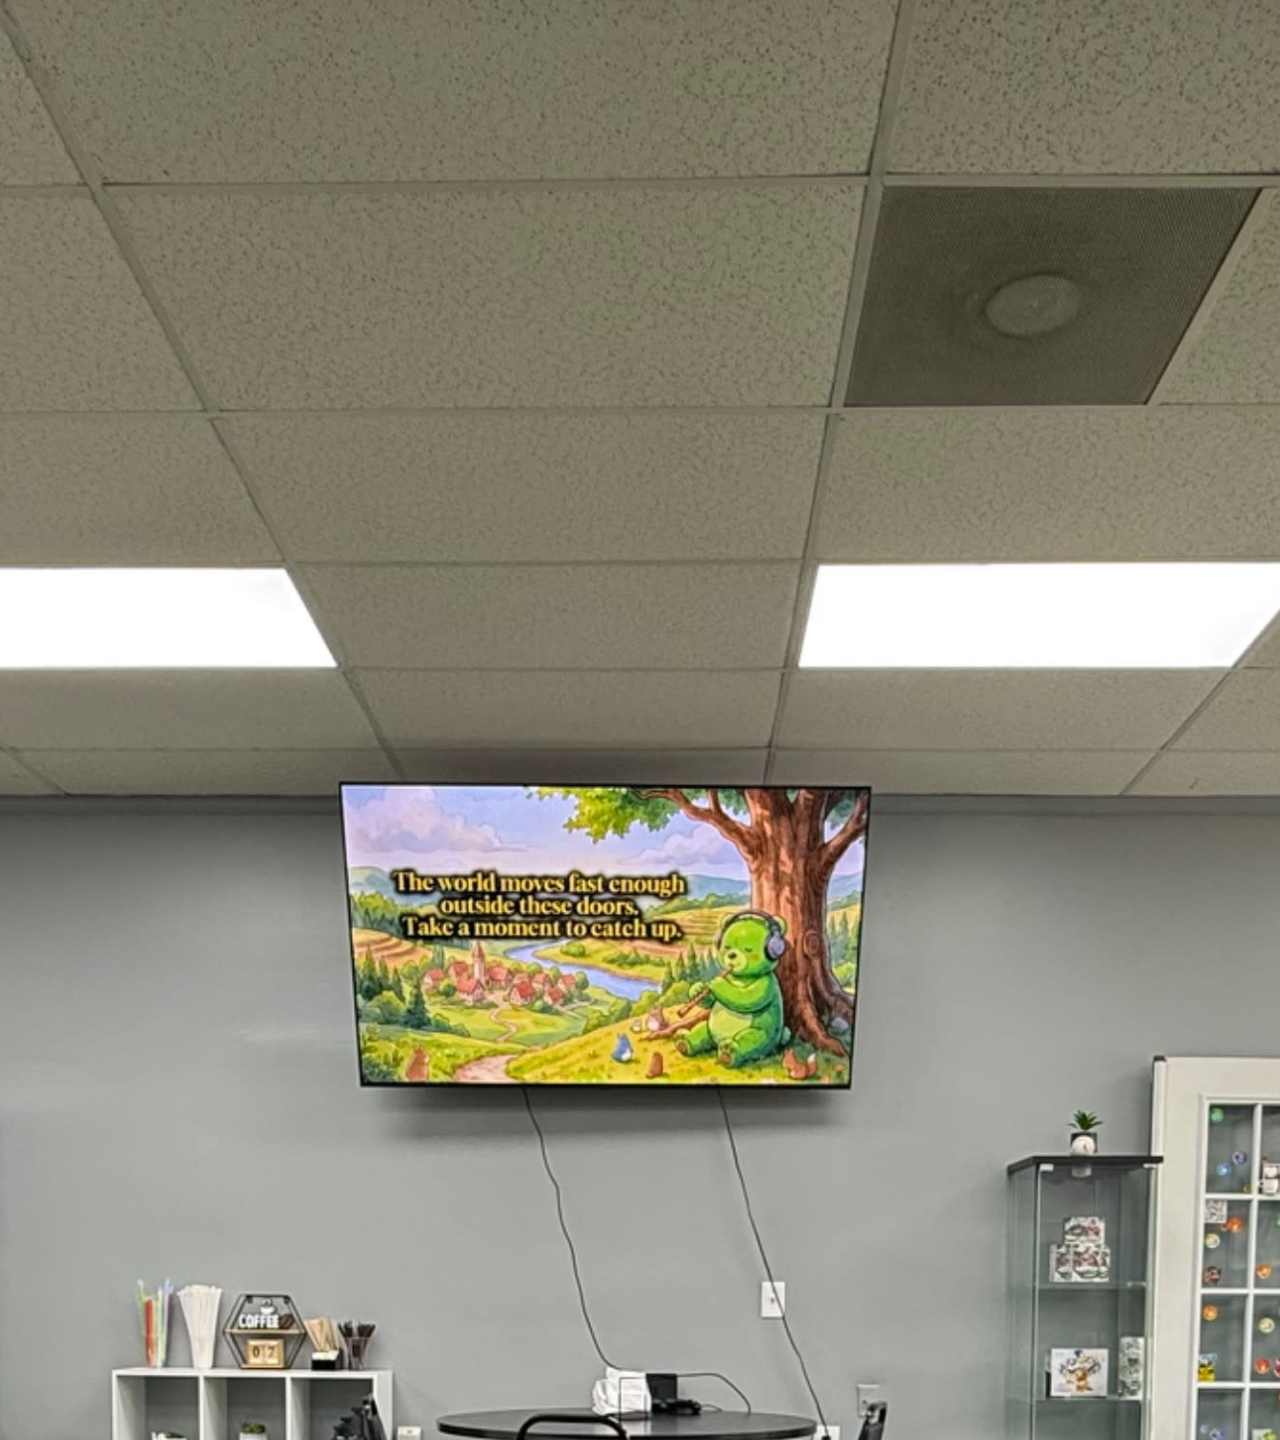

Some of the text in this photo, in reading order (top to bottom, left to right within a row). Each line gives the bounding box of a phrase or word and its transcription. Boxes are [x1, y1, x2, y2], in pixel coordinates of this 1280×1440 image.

[394, 871, 685, 897] The world moves fast enough
[440, 896, 639, 916] outside these doors.
[402, 917, 683, 942] Take a moment to catch up.
[239, 1313, 280, 1329] COFFEE
